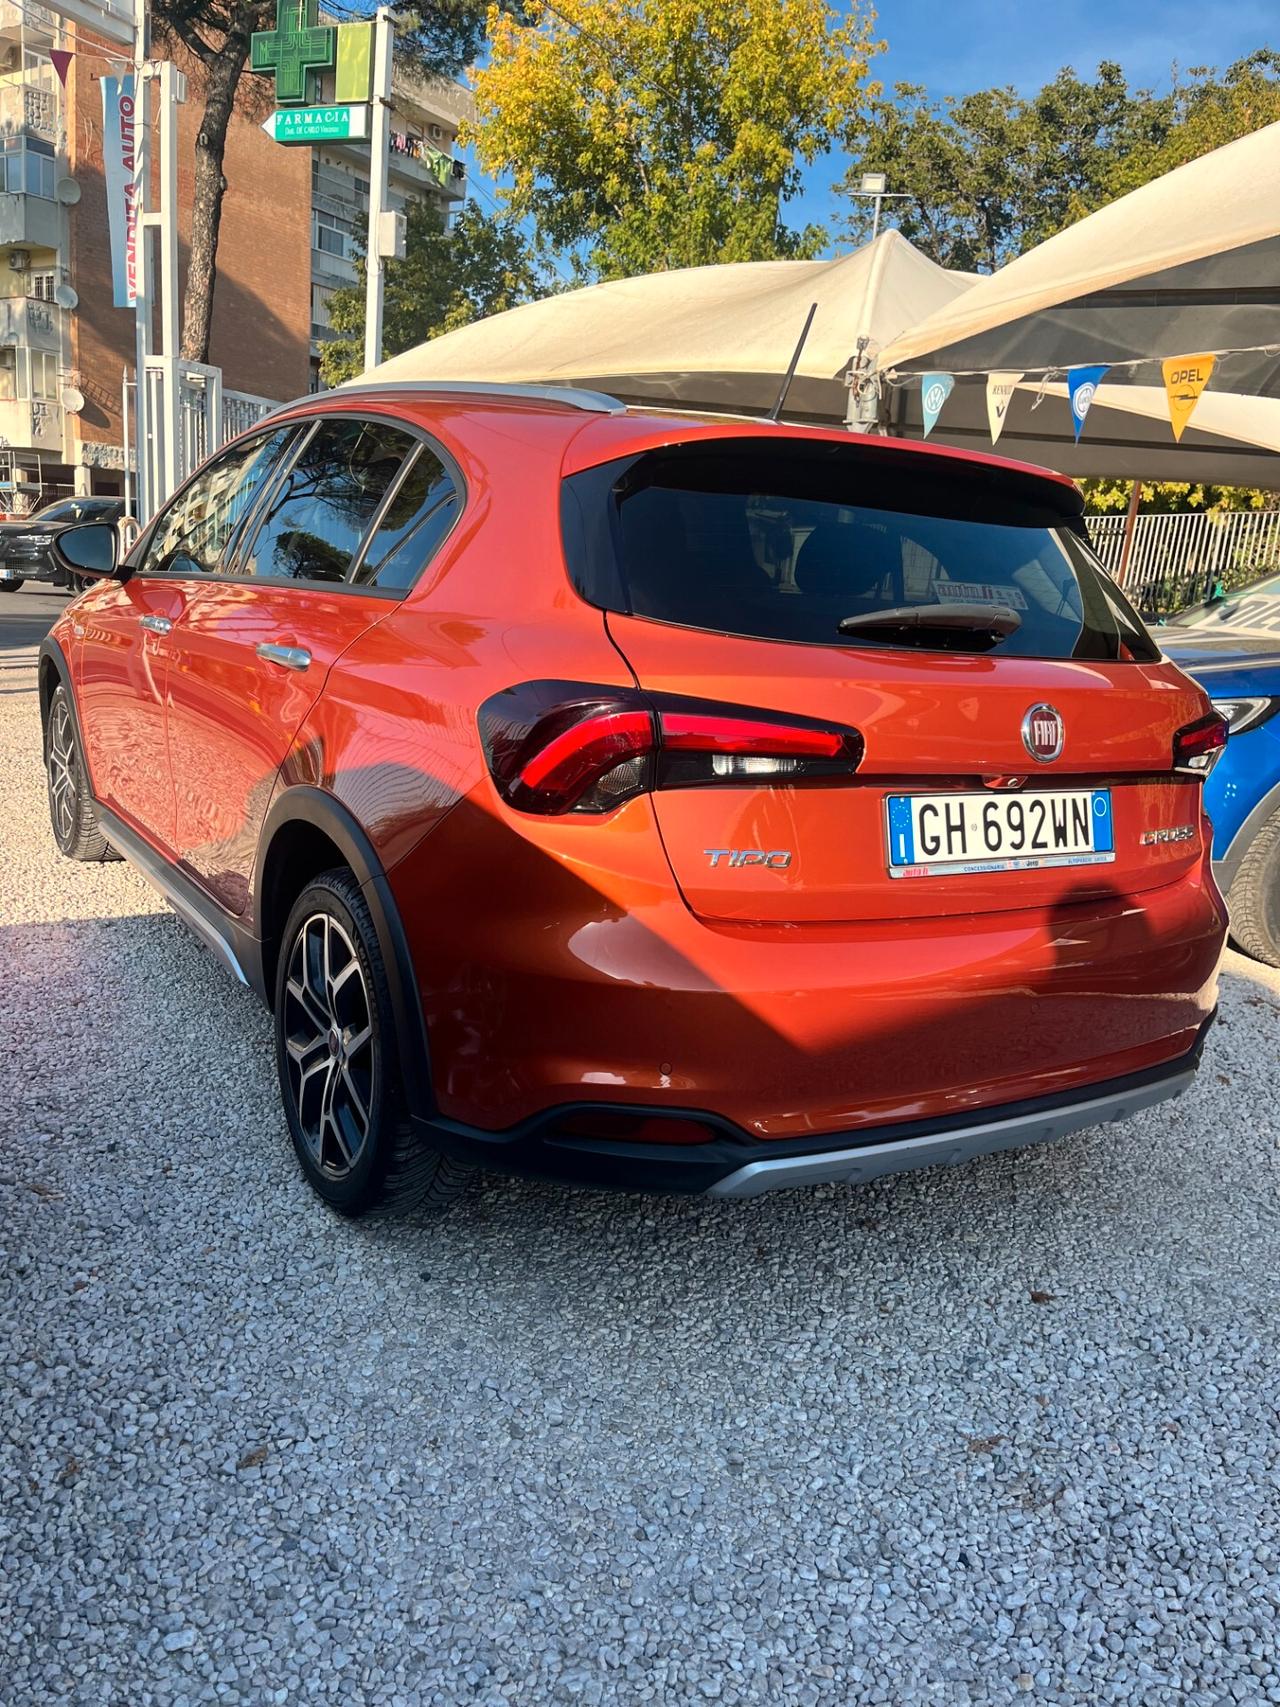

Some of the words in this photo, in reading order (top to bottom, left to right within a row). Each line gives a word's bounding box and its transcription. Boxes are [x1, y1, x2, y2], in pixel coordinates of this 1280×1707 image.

[276, 111, 349, 125] FARMACIA
[120, 95, 135, 173] AUTO
[1171, 368, 1204, 385] OPEL
[1033, 720, 1057, 746] FIAT
[919, 801, 967, 856] GH
[982, 797, 1090, 852] 692WN
[1139, 825, 1194, 846] CROSS
[703, 849, 792, 868] TIPO
